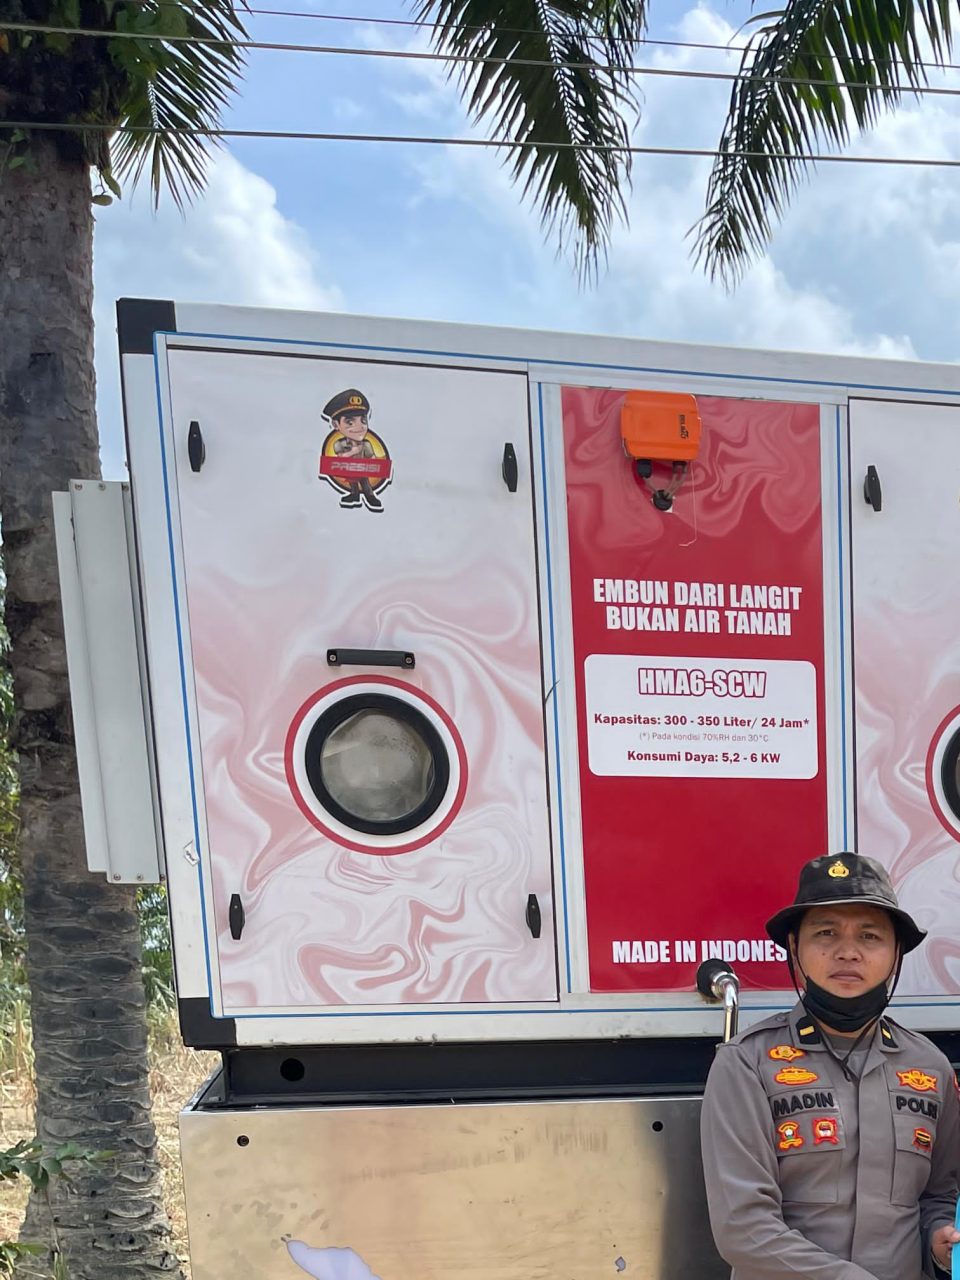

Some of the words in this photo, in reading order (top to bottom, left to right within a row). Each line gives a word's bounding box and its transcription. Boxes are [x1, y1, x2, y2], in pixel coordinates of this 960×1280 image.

[593, 579, 668, 604] EMBUN
[674, 582, 724, 607] DARI
[730, 585, 802, 610] LANGIT
[606, 606, 679, 631] BUKAN
[685, 609, 720, 633] AIR
[725, 611, 791, 636] TANAH
[638, 668, 766, 698] HMA6-SCW
[594, 714, 661, 726] Kapasitas:
[664, 716, 687, 726] 300
[697, 716, 720, 726] 350
[724, 717, 755, 729] Liter/
[762, 718, 776, 727] 24
[652, 732, 671, 740] Pada
[627, 751, 681, 762] Konsumi
[685, 752, 718, 764] Daya:
[722, 753, 740, 764] 5,2
[750, 753, 757, 763] 6
[761, 754, 780, 763] KW
[612, 940, 670, 963] MADE
[676, 940, 696, 962] IN
[701, 940, 787, 962] INDONES
[774, 1092, 834, 1116] MADIN
